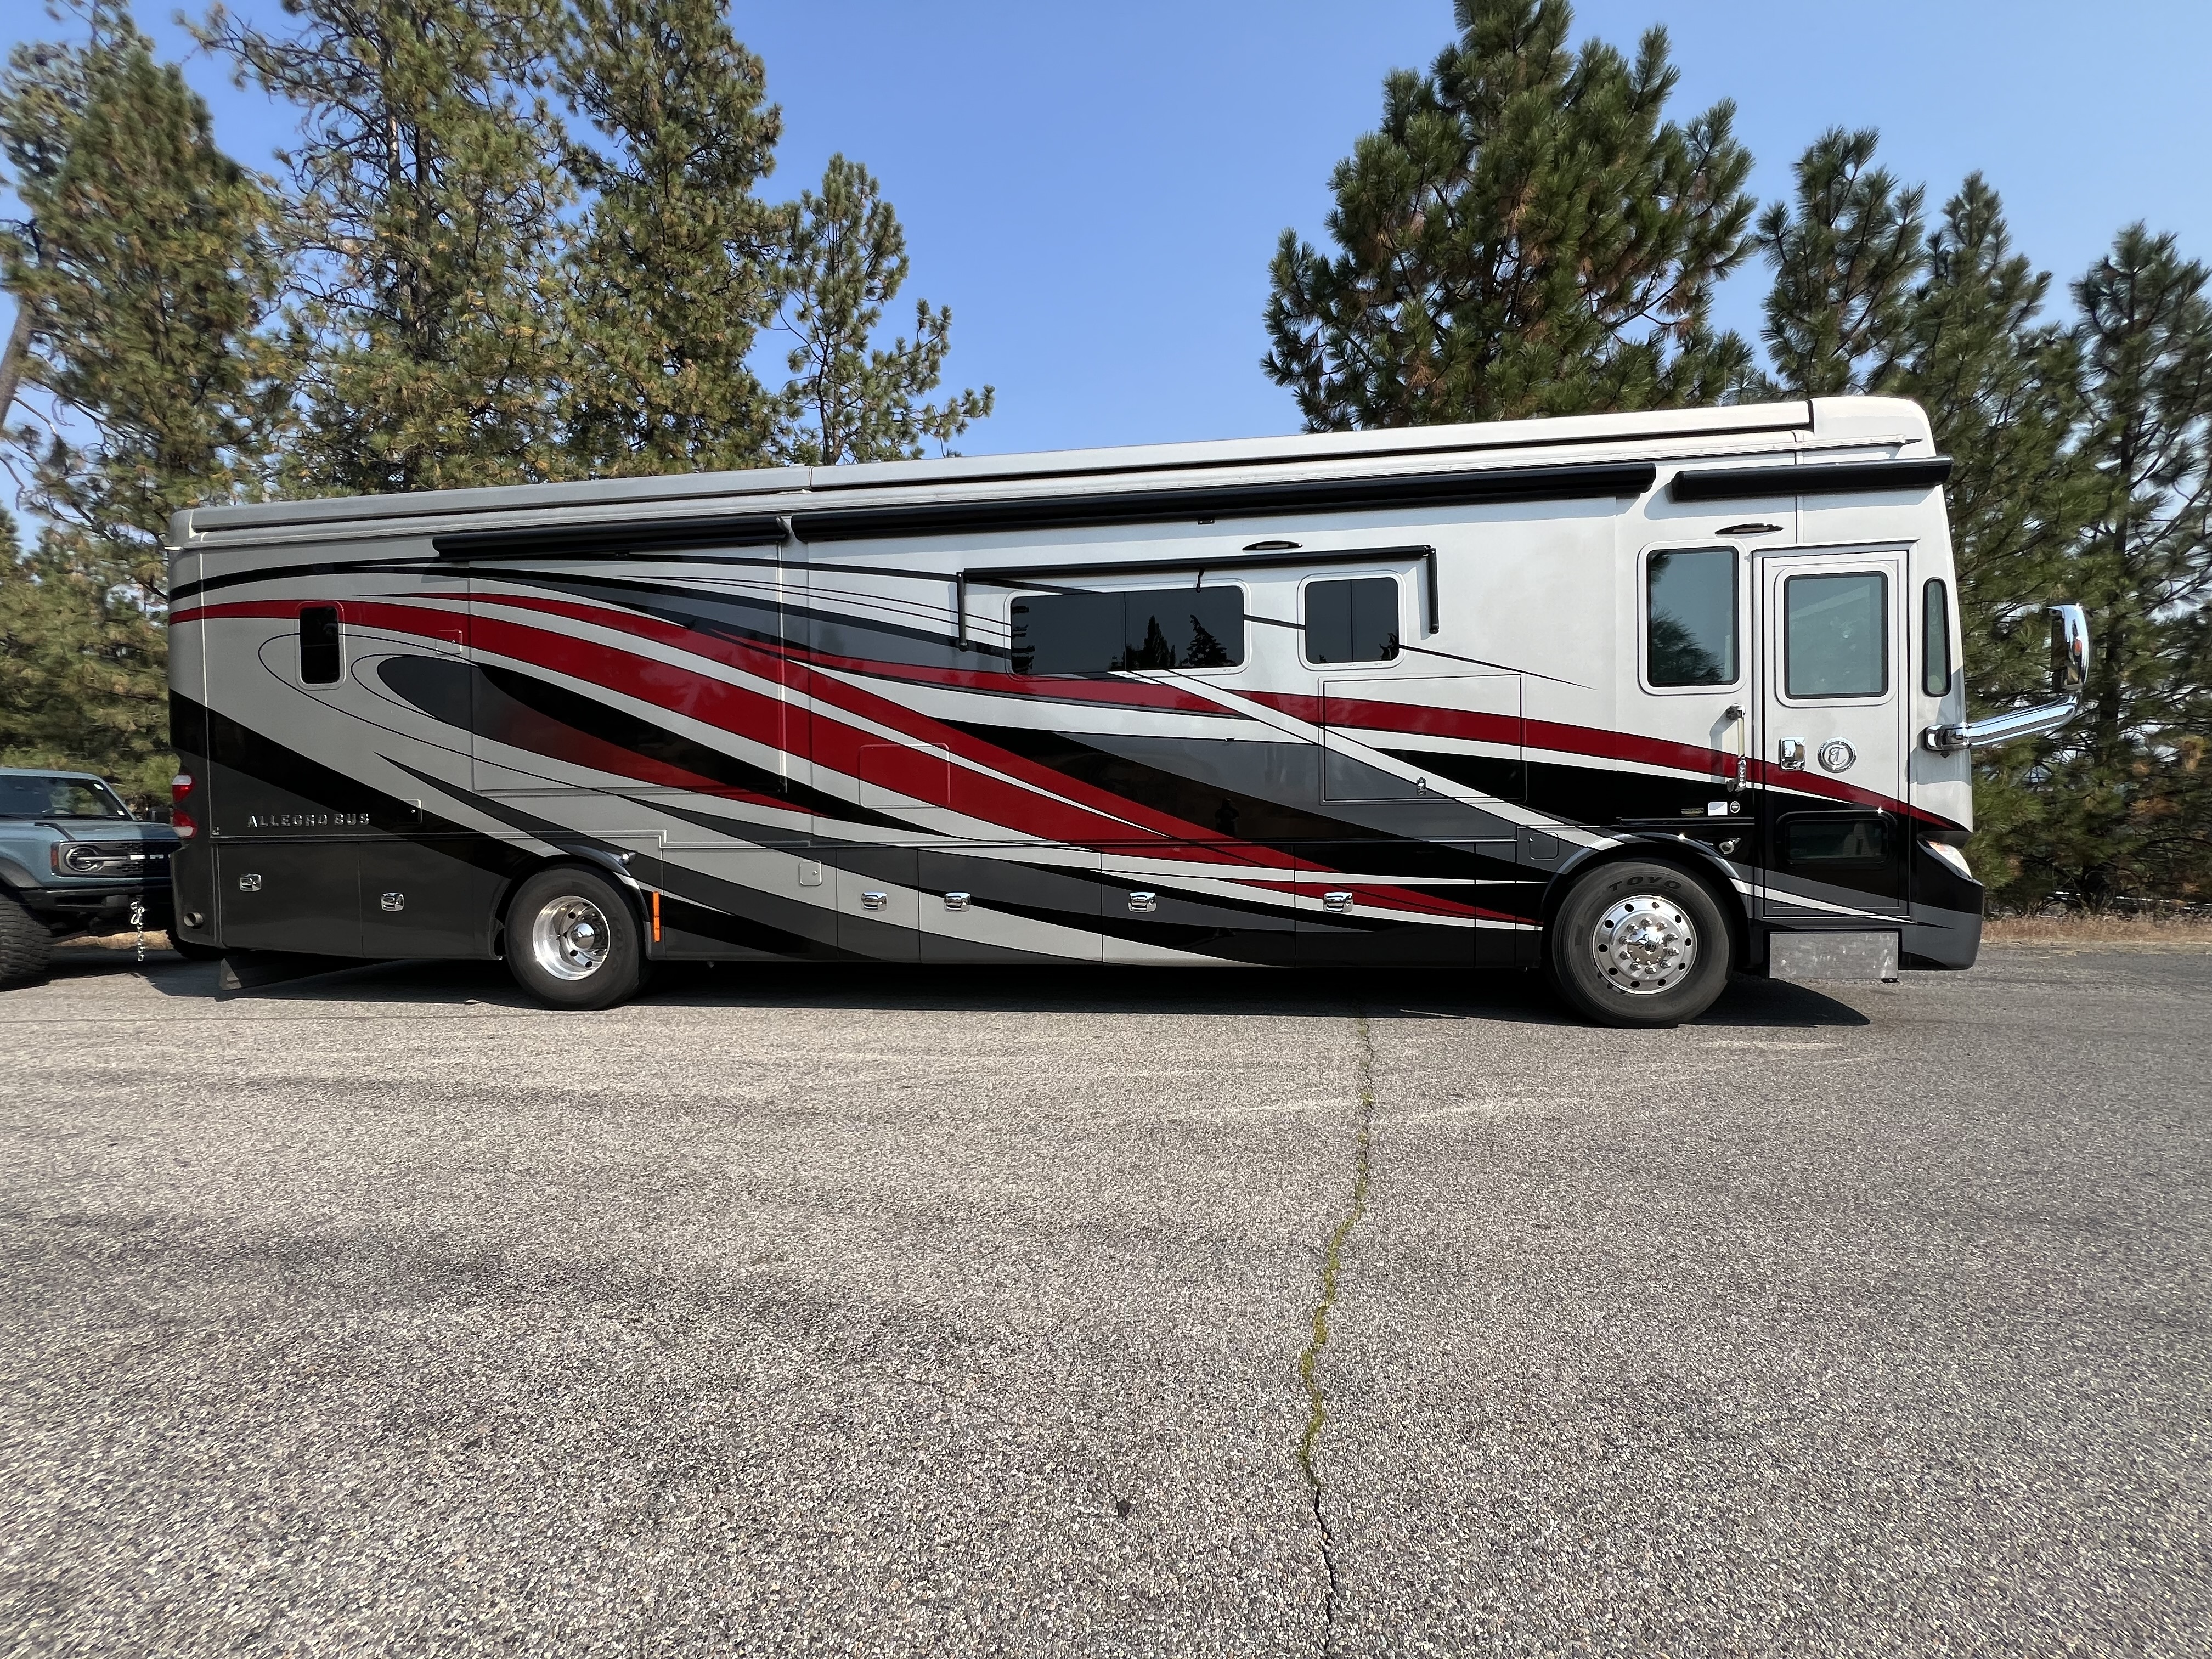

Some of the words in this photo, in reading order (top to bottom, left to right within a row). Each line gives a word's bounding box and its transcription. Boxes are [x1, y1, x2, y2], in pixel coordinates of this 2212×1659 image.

[247, 814, 328, 827] ALLEGRO
[334, 813, 369, 826] BUS
[1607, 876, 1683, 892] TOYO
